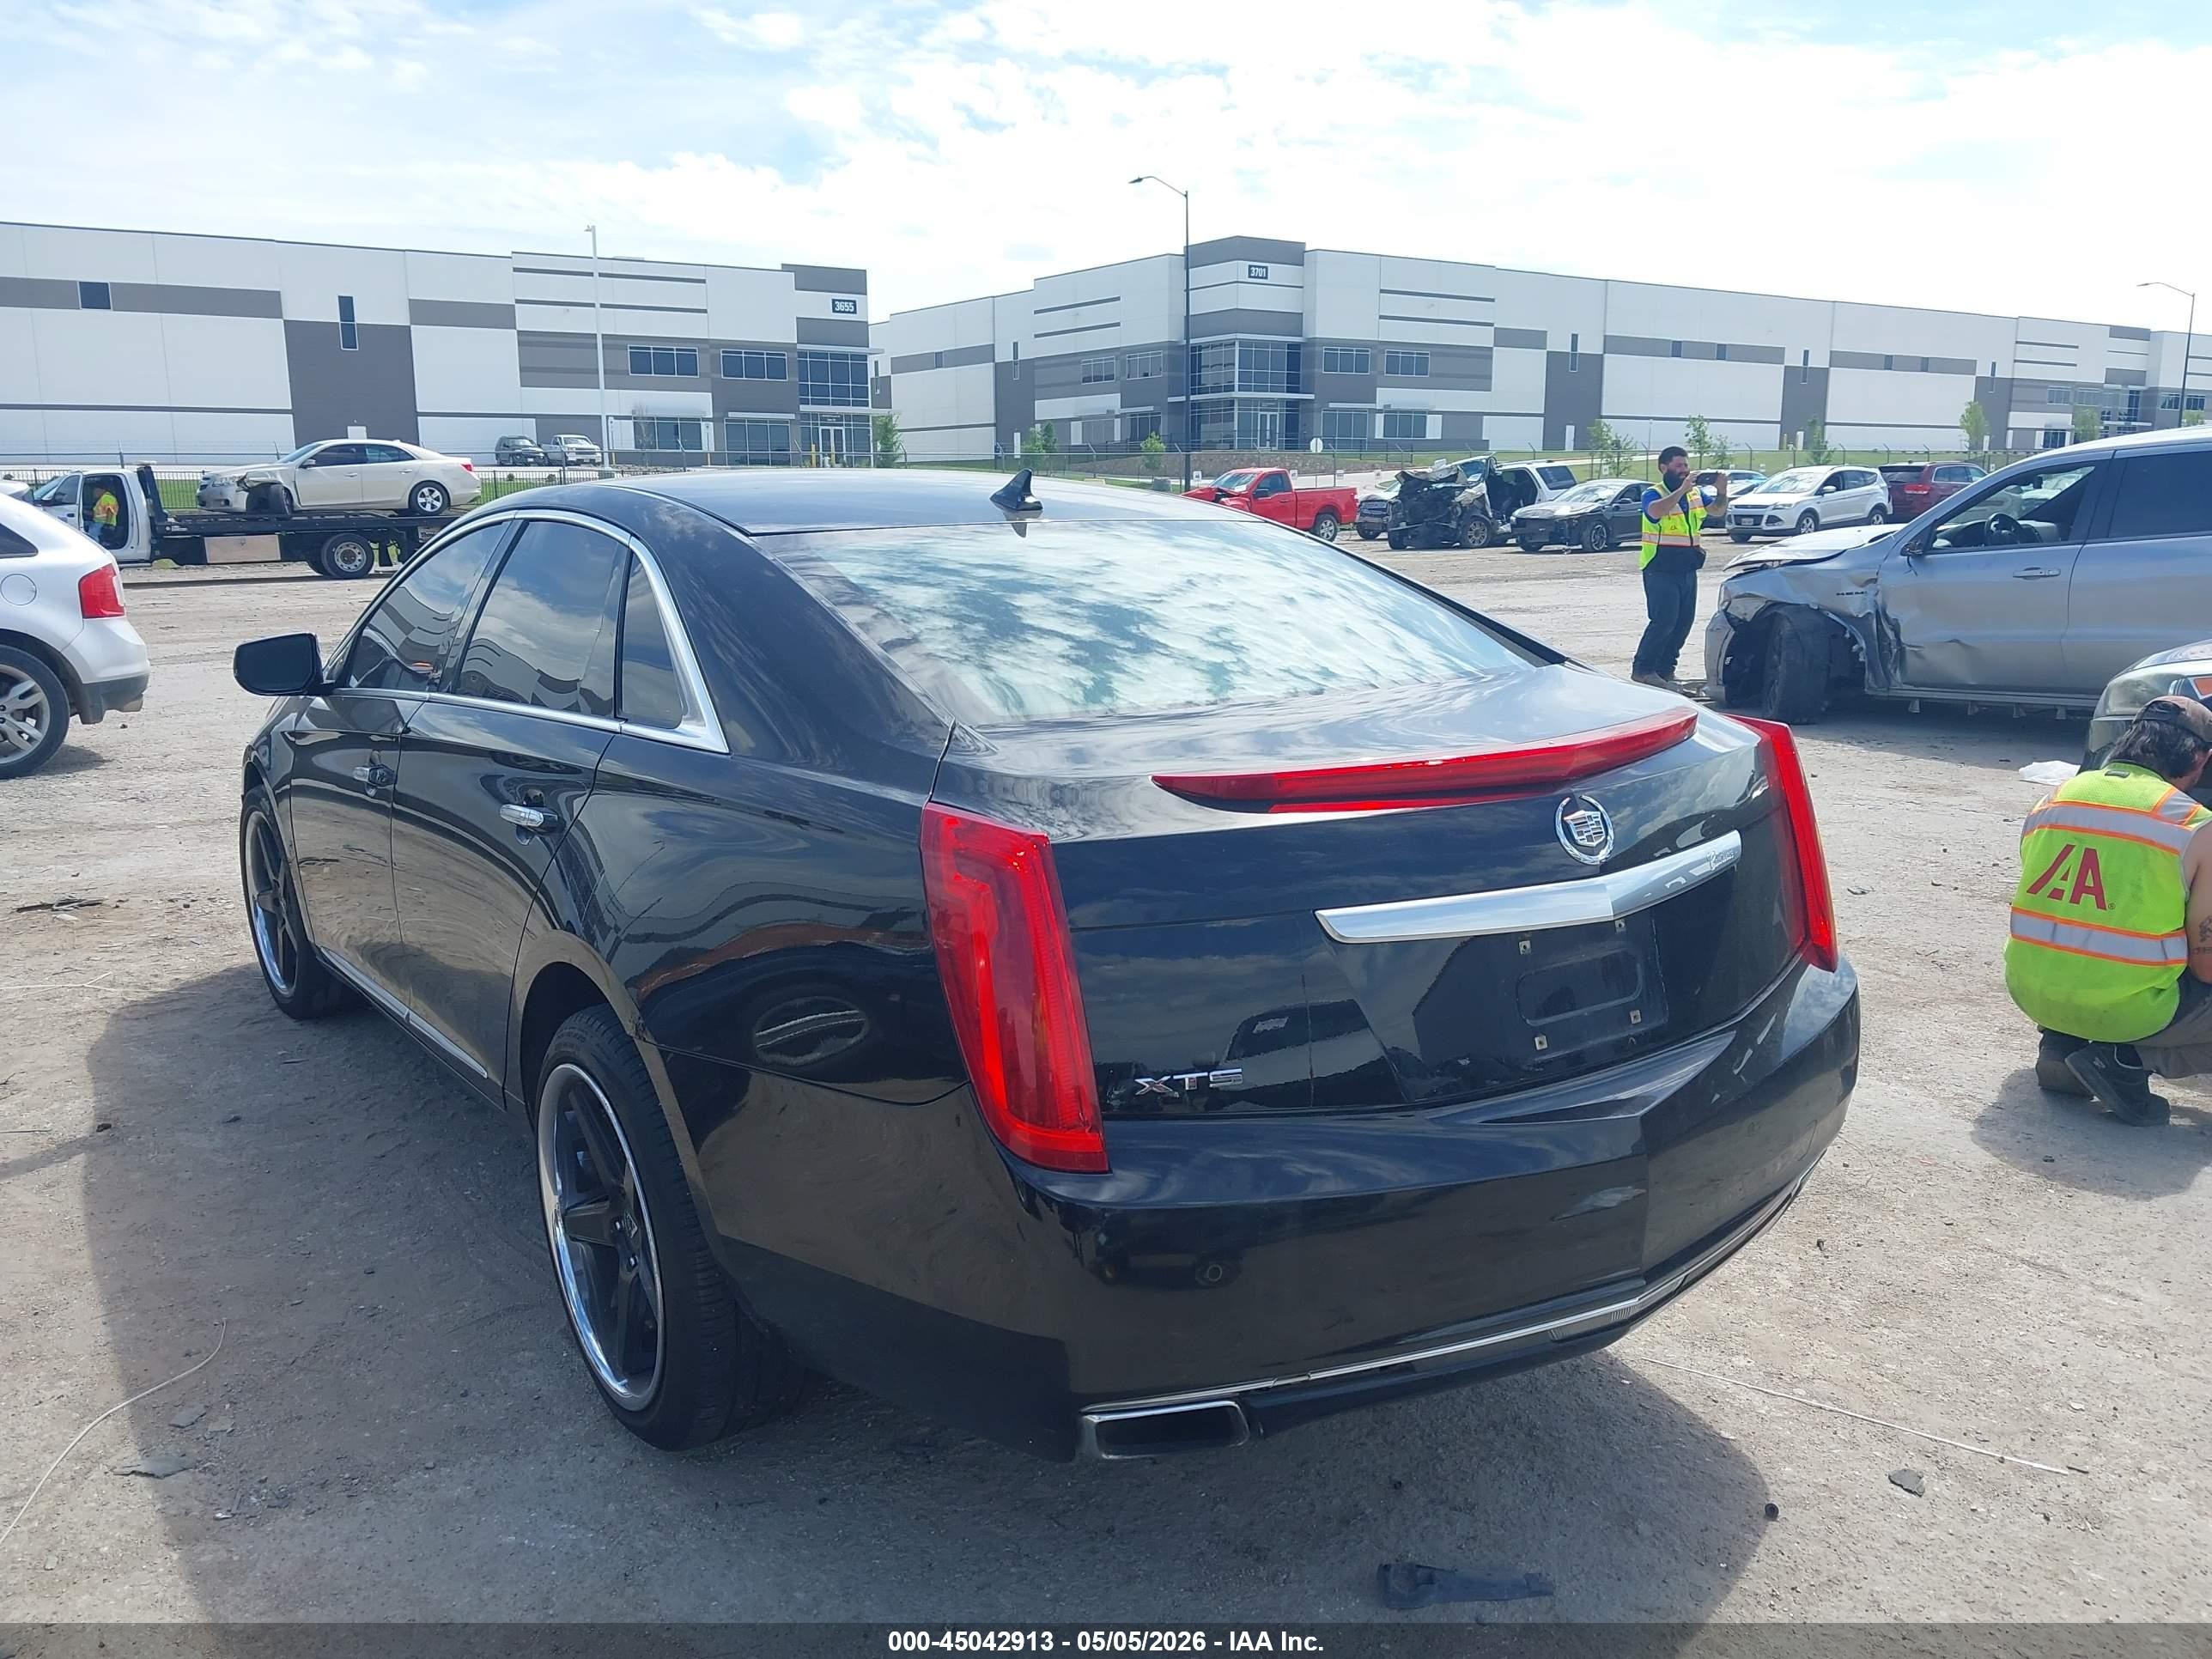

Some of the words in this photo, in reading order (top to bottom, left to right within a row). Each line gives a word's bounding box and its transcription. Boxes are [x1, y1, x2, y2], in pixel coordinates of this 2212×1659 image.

[1250, 267, 1267, 277] 3701
[835, 301, 854, 313] 3655
[1134, 1068, 1243, 1097] XTS
